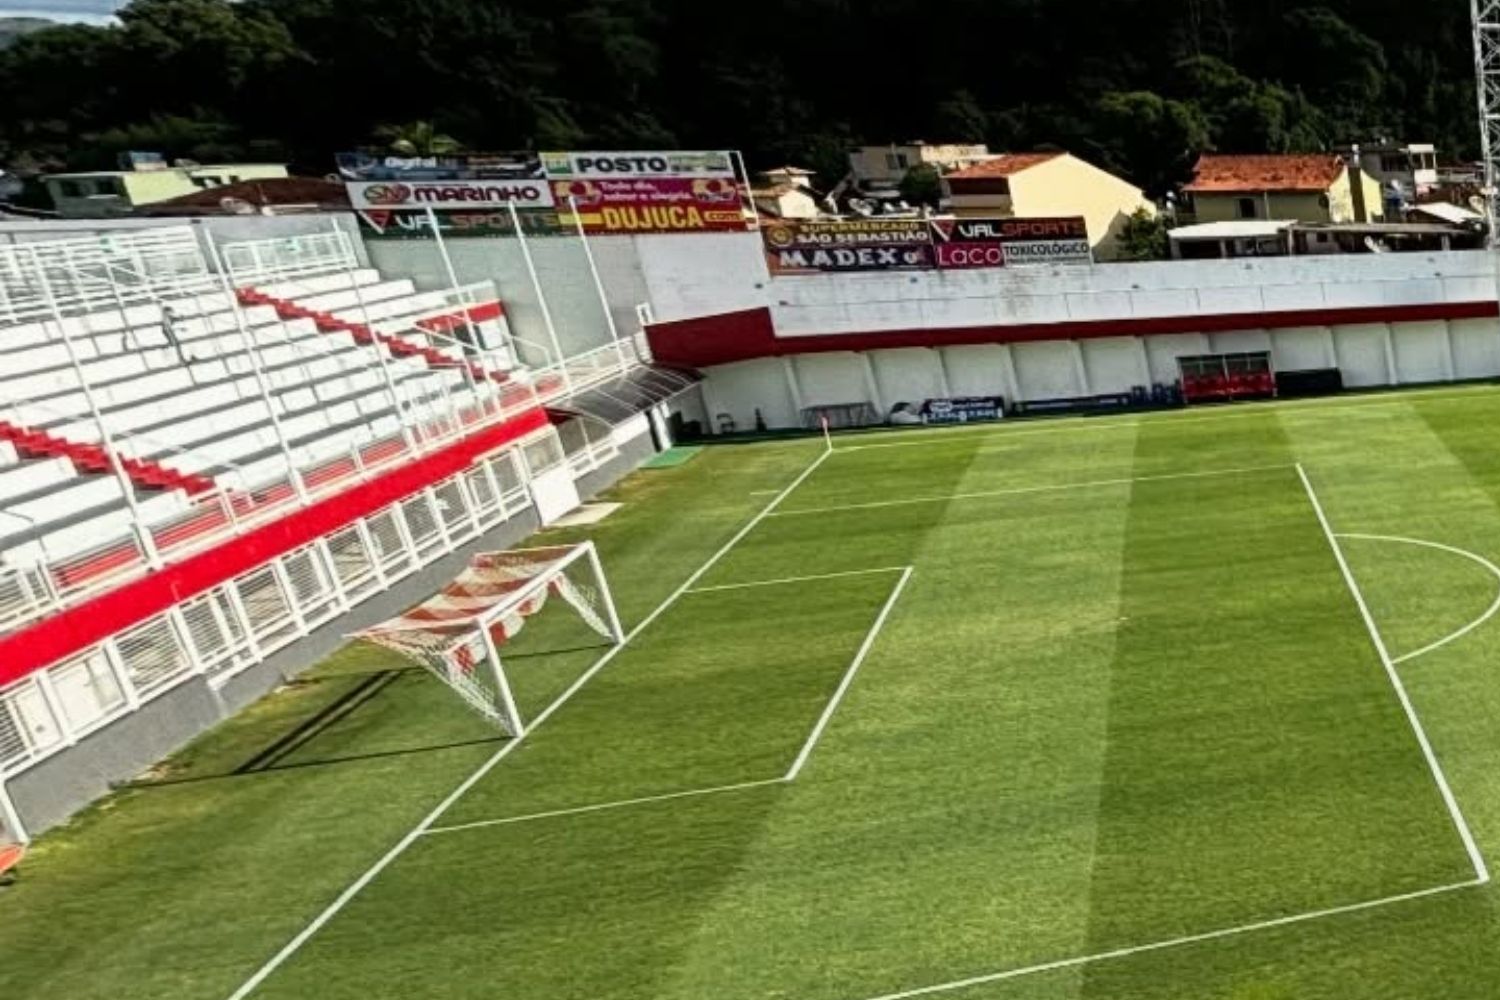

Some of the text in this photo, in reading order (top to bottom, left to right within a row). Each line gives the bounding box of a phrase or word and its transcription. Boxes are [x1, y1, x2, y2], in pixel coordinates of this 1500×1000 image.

[575, 157, 667, 172] POSTO
[414, 185, 541, 201] MARINHO
[601, 206, 705, 229] DUJUCA
[800, 222, 919, 233] SUPERMERCADO
[1001, 221, 1084, 236] SPORTS
[797, 230, 928, 243] SÃO SEBASTIÃO
[779, 248, 896, 266] MADEX
[1004, 242, 1088, 257] TOXICOLÓGICO
